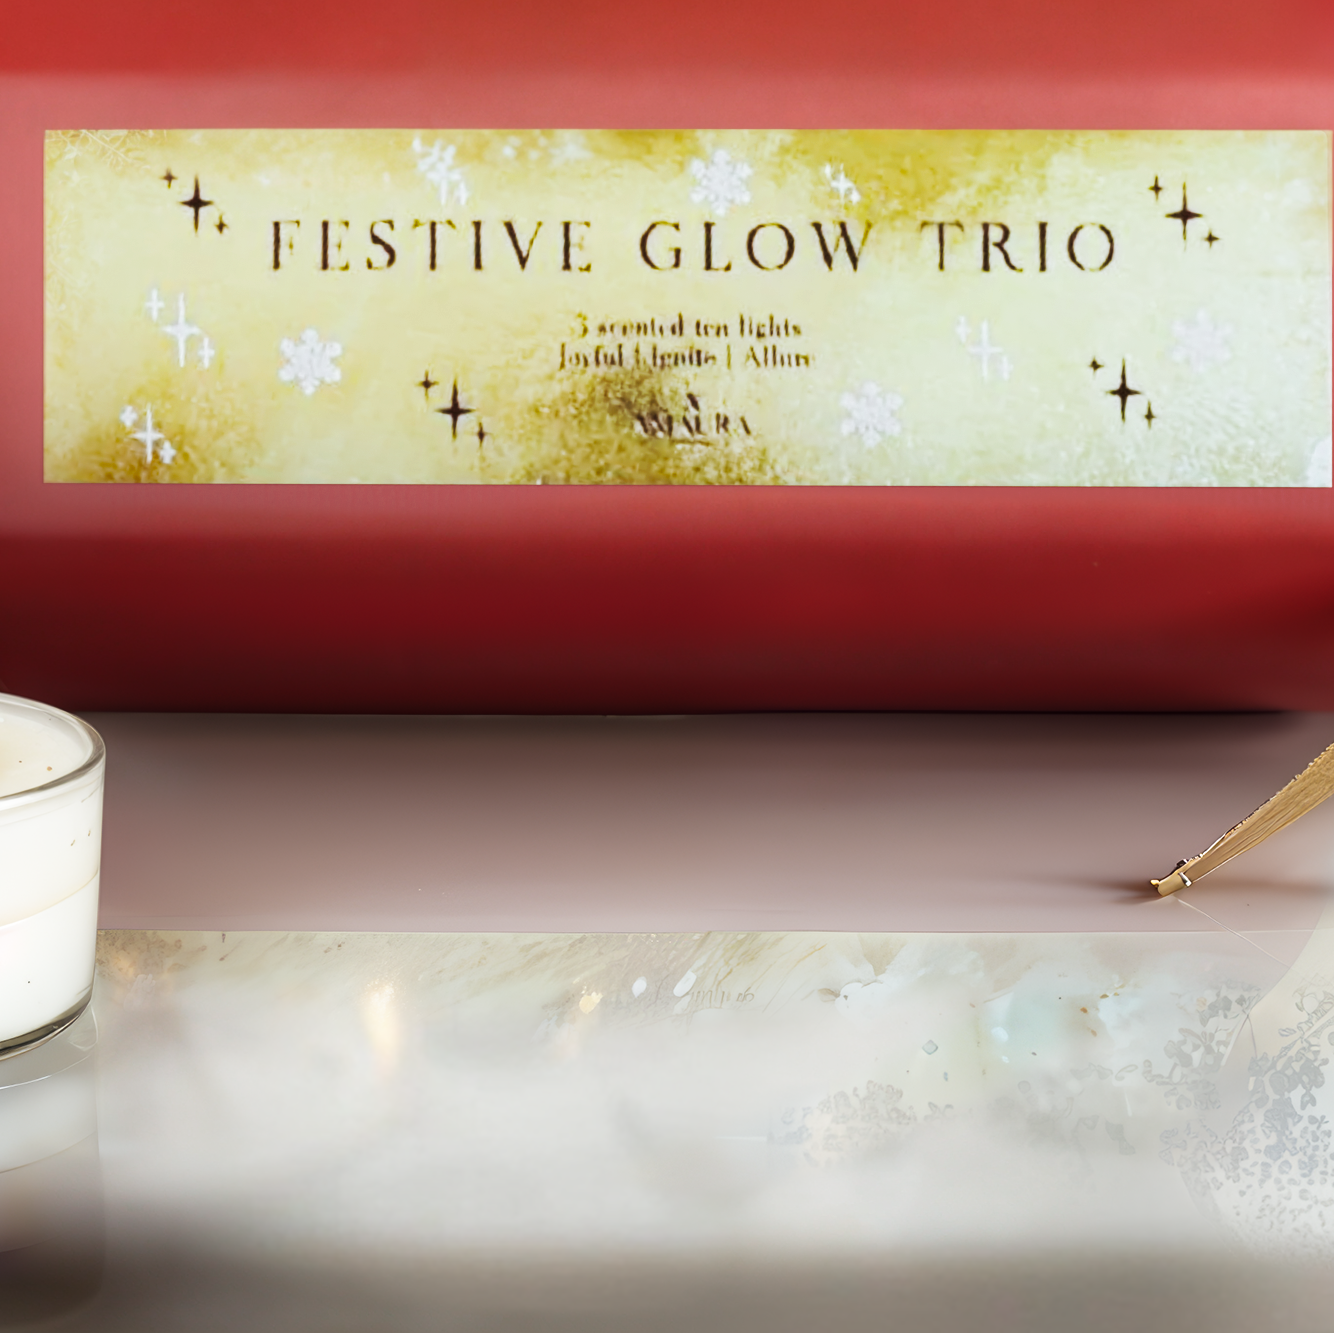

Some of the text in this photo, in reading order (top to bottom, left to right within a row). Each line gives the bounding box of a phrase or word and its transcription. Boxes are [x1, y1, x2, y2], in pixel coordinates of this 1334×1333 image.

[270, 219, 1115, 273] FESTIVE GLOW TRIO
